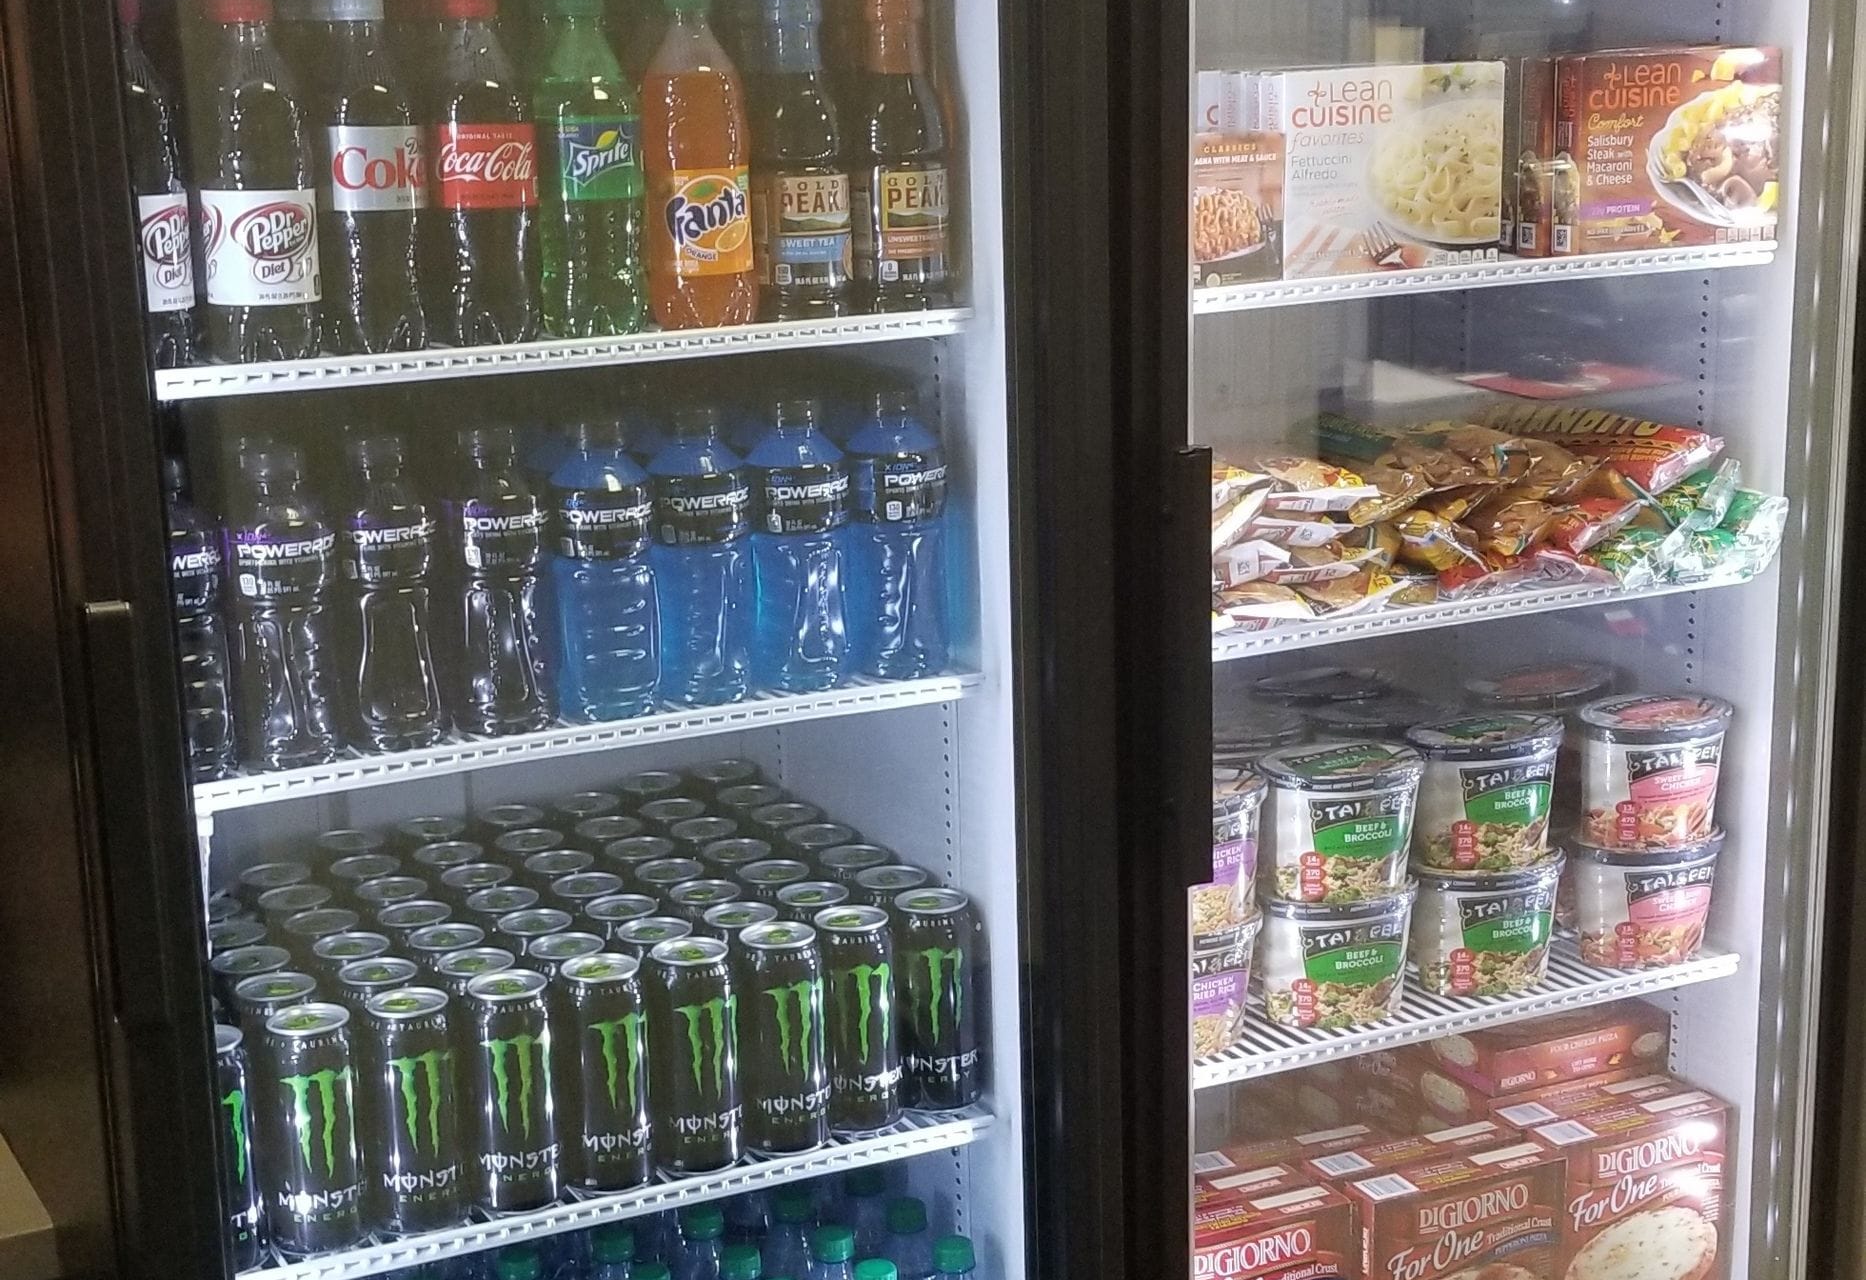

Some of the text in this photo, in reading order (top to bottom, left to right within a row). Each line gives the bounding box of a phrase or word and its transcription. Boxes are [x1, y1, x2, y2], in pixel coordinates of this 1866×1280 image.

[1623, 63, 1681, 85] Lean
[1330, 79, 1393, 104] Lean
[1588, 113, 1644, 133] Comfort
[1203, 143, 1257, 154] CLASSICS
[1288, 131, 1365, 155] favorites
[1588, 134, 1634, 148] Salisbury
[573, 137, 629, 177] Sprite
[1194, 157, 1213, 166] AGNA
[1213, 156, 1231, 164] WITH
[1231, 154, 1248, 163] MEAT
[1256, 153, 1277, 162] SAUCE
[1291, 155, 1352, 168] Fettuccini
[1587, 147, 1633, 160] Steak with
[1292, 169, 1338, 181] Alfredo
[1587, 158, 1633, 173] Macaroni
[1586, 174, 1633, 186] & Cheese
[665, 186, 746, 248] Fanta
[1606, 204, 1640, 214] PROTEIN
[269, 210, 295, 234] Dr
[149, 220, 190, 260] Pepp
[246, 217, 307, 255] Pepper
[820, 238, 835, 247] TEA
[262, 262, 285, 279] Diet
[884, 464, 947, 487] POWER
[1476, 770, 1510, 791] TAI
[1661, 780, 1700, 791] CHIC
[1494, 797, 1531, 810] BROCCO
[1504, 789, 1526, 800] BEEF
[1325, 794, 1411, 820] TAI PE
[1344, 828, 1392, 843] BROCCOLI
[1355, 822, 1379, 833] BEEF
[1213, 845, 1242, 860] ICKEN
[1641, 874, 1673, 892] TAI
[1474, 899, 1508, 917] TAI
[1493, 925, 1532, 939] BROCCO
[1503, 918, 1525, 929] BEEF
[1316, 930, 1351, 949] TAI
[1335, 955, 1384, 970] BROCCOLI
[1346, 949, 1370, 960] BEEF
[1193, 982, 1236, 1001] RIED RICE
[901, 1049, 978, 1073] ONSTER
[834, 1065, 903, 1093] ONSTER
[755, 1085, 831, 1114] MONST
[856, 1088, 898, 1103] ERGY
[670, 1104, 743, 1134] MONST
[771, 1103, 831, 1125] ENERG
[582, 1123, 652, 1152] MONST
[479, 1144, 561, 1173] MONSTE
[1598, 1135, 1699, 1174] DIGIORNO
[383, 1162, 464, 1193] MONST
[279, 1180, 367, 1212] MNST
[1569, 1190, 1610, 1232] For
[1610, 1174, 1658, 1214] One
[294, 1206, 357, 1223] ENERG
[1419, 1183, 1529, 1230] DIGIORNO
[1487, 1216, 1553, 1245] Traditional Crust
[1194, 1228, 1312, 1278] DIGIORNO
[1433, 1230, 1484, 1270] One
[1315, 1263, 1338, 1274] Crust
